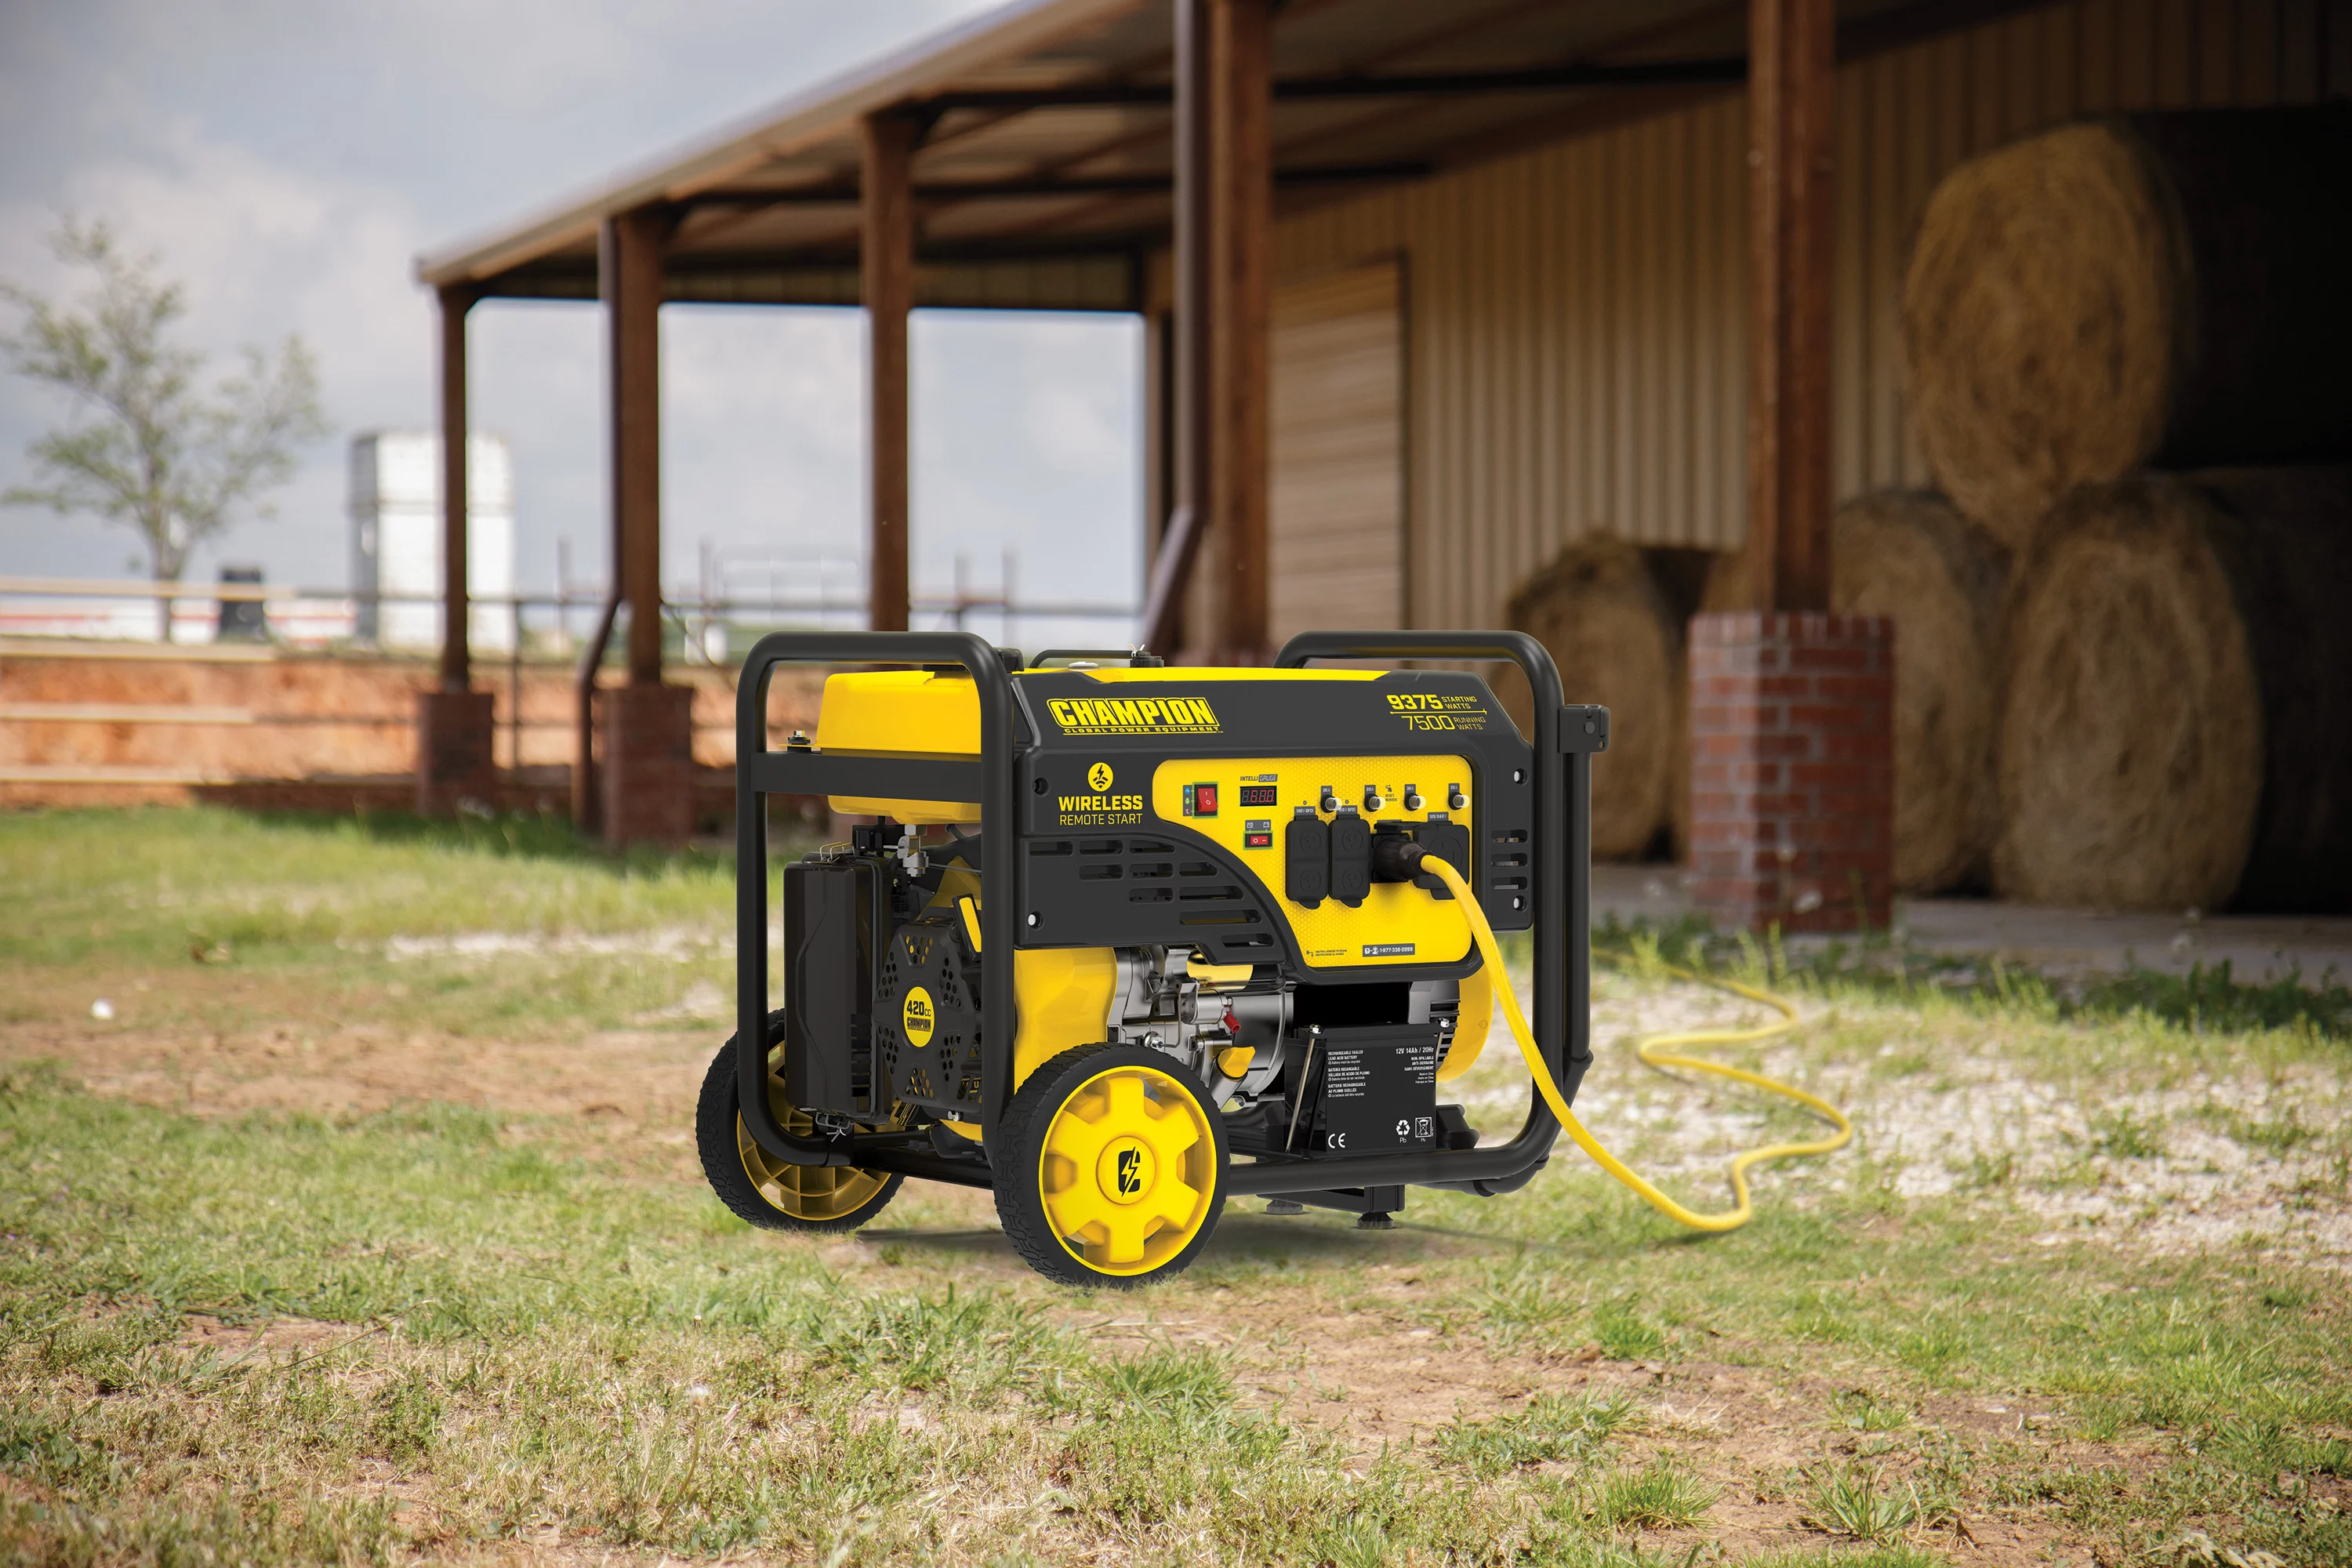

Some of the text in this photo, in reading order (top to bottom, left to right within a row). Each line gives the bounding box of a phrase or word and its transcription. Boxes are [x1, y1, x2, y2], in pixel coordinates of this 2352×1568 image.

[1386, 694, 1443, 710] 9375
[1050, 699, 1218, 726] CHAMPION
[1401, 715, 1456, 731] 7500
[1058, 795, 1143, 812] WIRELESS
[1060, 813, 1143, 826] REMOTE START
[906, 1017, 931, 1029] CHAMPION
[1327, 1133, 1346, 1149] CE
